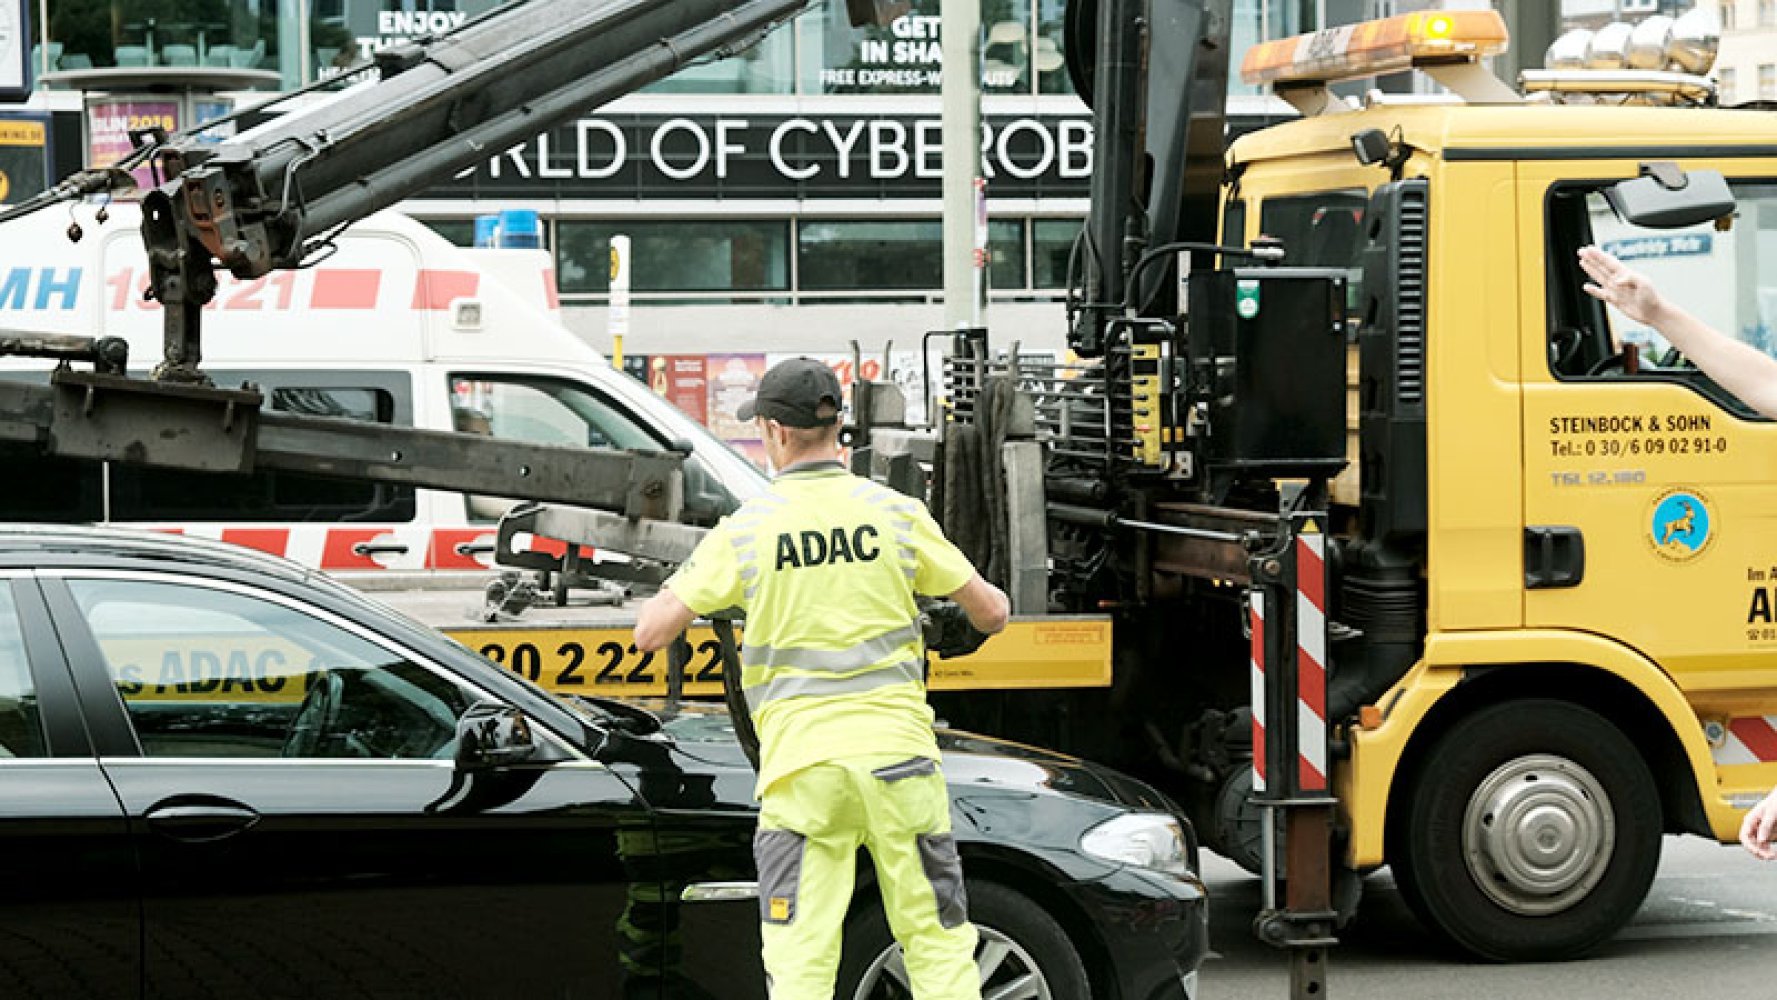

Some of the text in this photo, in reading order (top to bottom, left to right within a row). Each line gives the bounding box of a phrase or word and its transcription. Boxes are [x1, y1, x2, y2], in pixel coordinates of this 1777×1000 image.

[379, 11, 465, 34] ENJOY
[892, 15, 942, 38] GET
[861, 40, 888, 63] IN
[650, 118, 749, 179] OF
[1550, 414, 1711, 434] STEINBOCK & SOHN
[1551, 440, 1581, 457] Tel.:
[1645, 437, 1664, 455] 09
[1669, 437, 1689, 454] 02
[1694, 436, 1727, 455] 91-0
[775, 524, 880, 571] ADAC
[155, 649, 287, 694] ADAC
